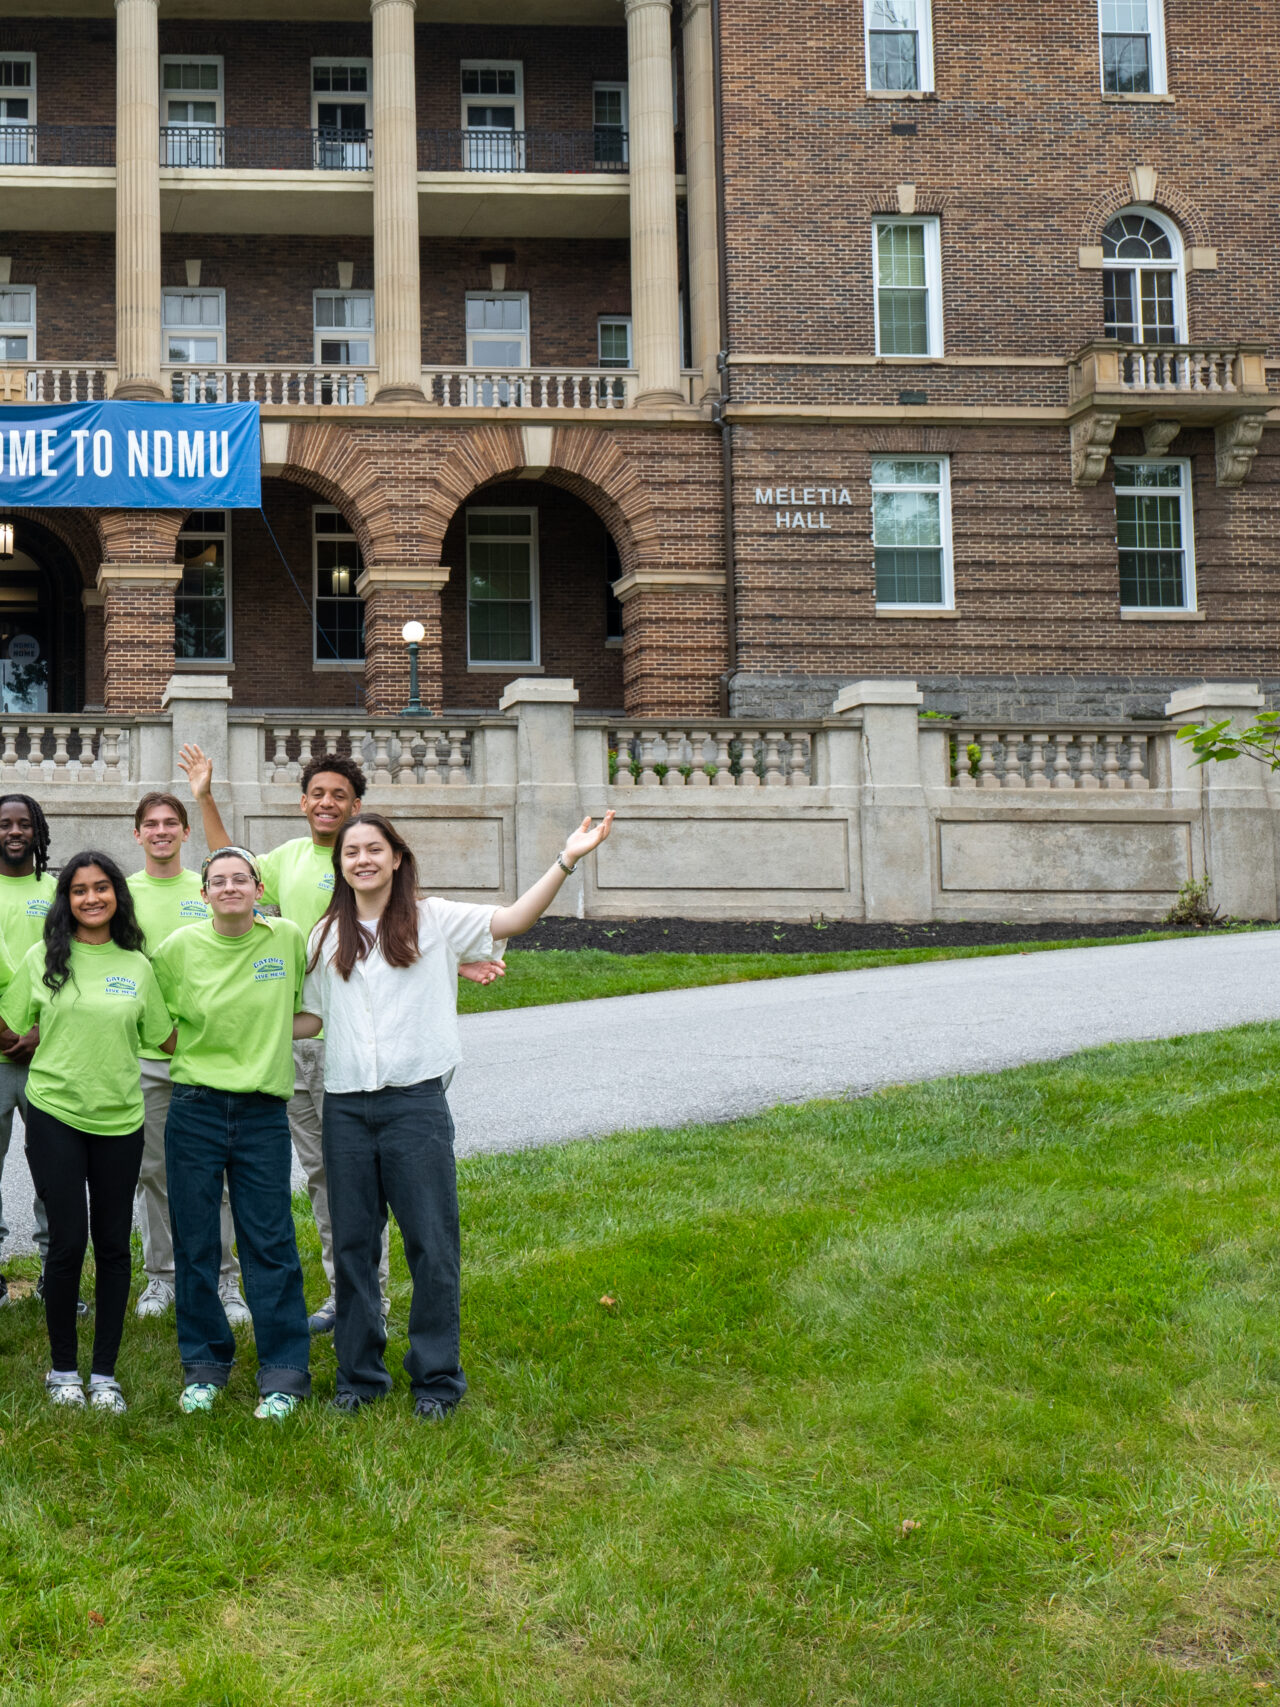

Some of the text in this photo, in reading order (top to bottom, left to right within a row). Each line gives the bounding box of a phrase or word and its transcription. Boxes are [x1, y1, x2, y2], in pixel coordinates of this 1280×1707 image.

[71, 429, 113, 478] TO
[128, 430, 229, 478] NDMU
[755, 487, 853, 505] MELETIA
[775, 511, 832, 529] HALL
